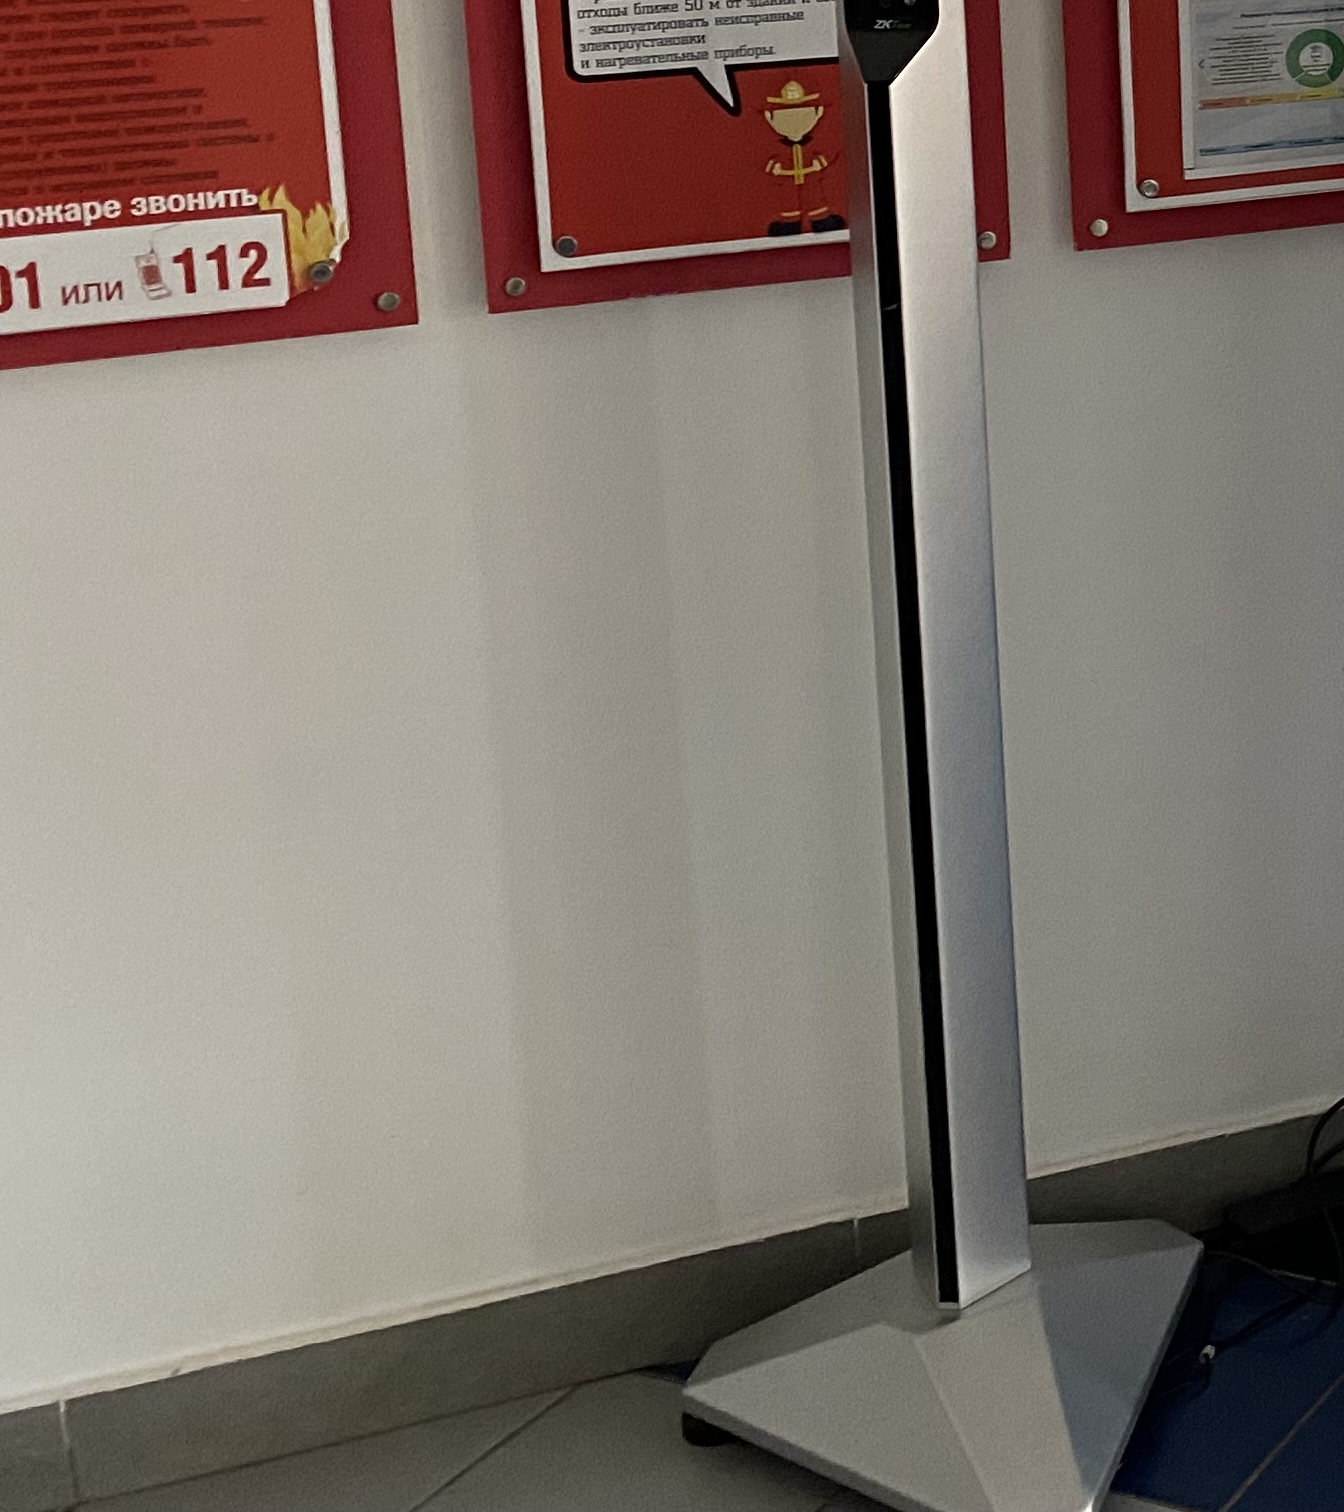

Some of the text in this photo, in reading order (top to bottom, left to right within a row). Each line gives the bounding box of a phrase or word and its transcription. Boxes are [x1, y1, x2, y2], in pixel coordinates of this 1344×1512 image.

[576, 6, 629, 20] отходы
[633, 2, 679, 16] ближе
[709, 0, 720, 10] м
[726, 0, 742, 9] от
[589, 11, 805, 35] эксплуатировать неисправные
[579, 34, 707, 53] электроустановки
[580, 59, 590, 69] и
[595, 50, 709, 69] нагревательные
[0, 188, 259, 227] пожаре звонить
[61, 280, 123, 306] или
[172, 241, 272, 294] 112
